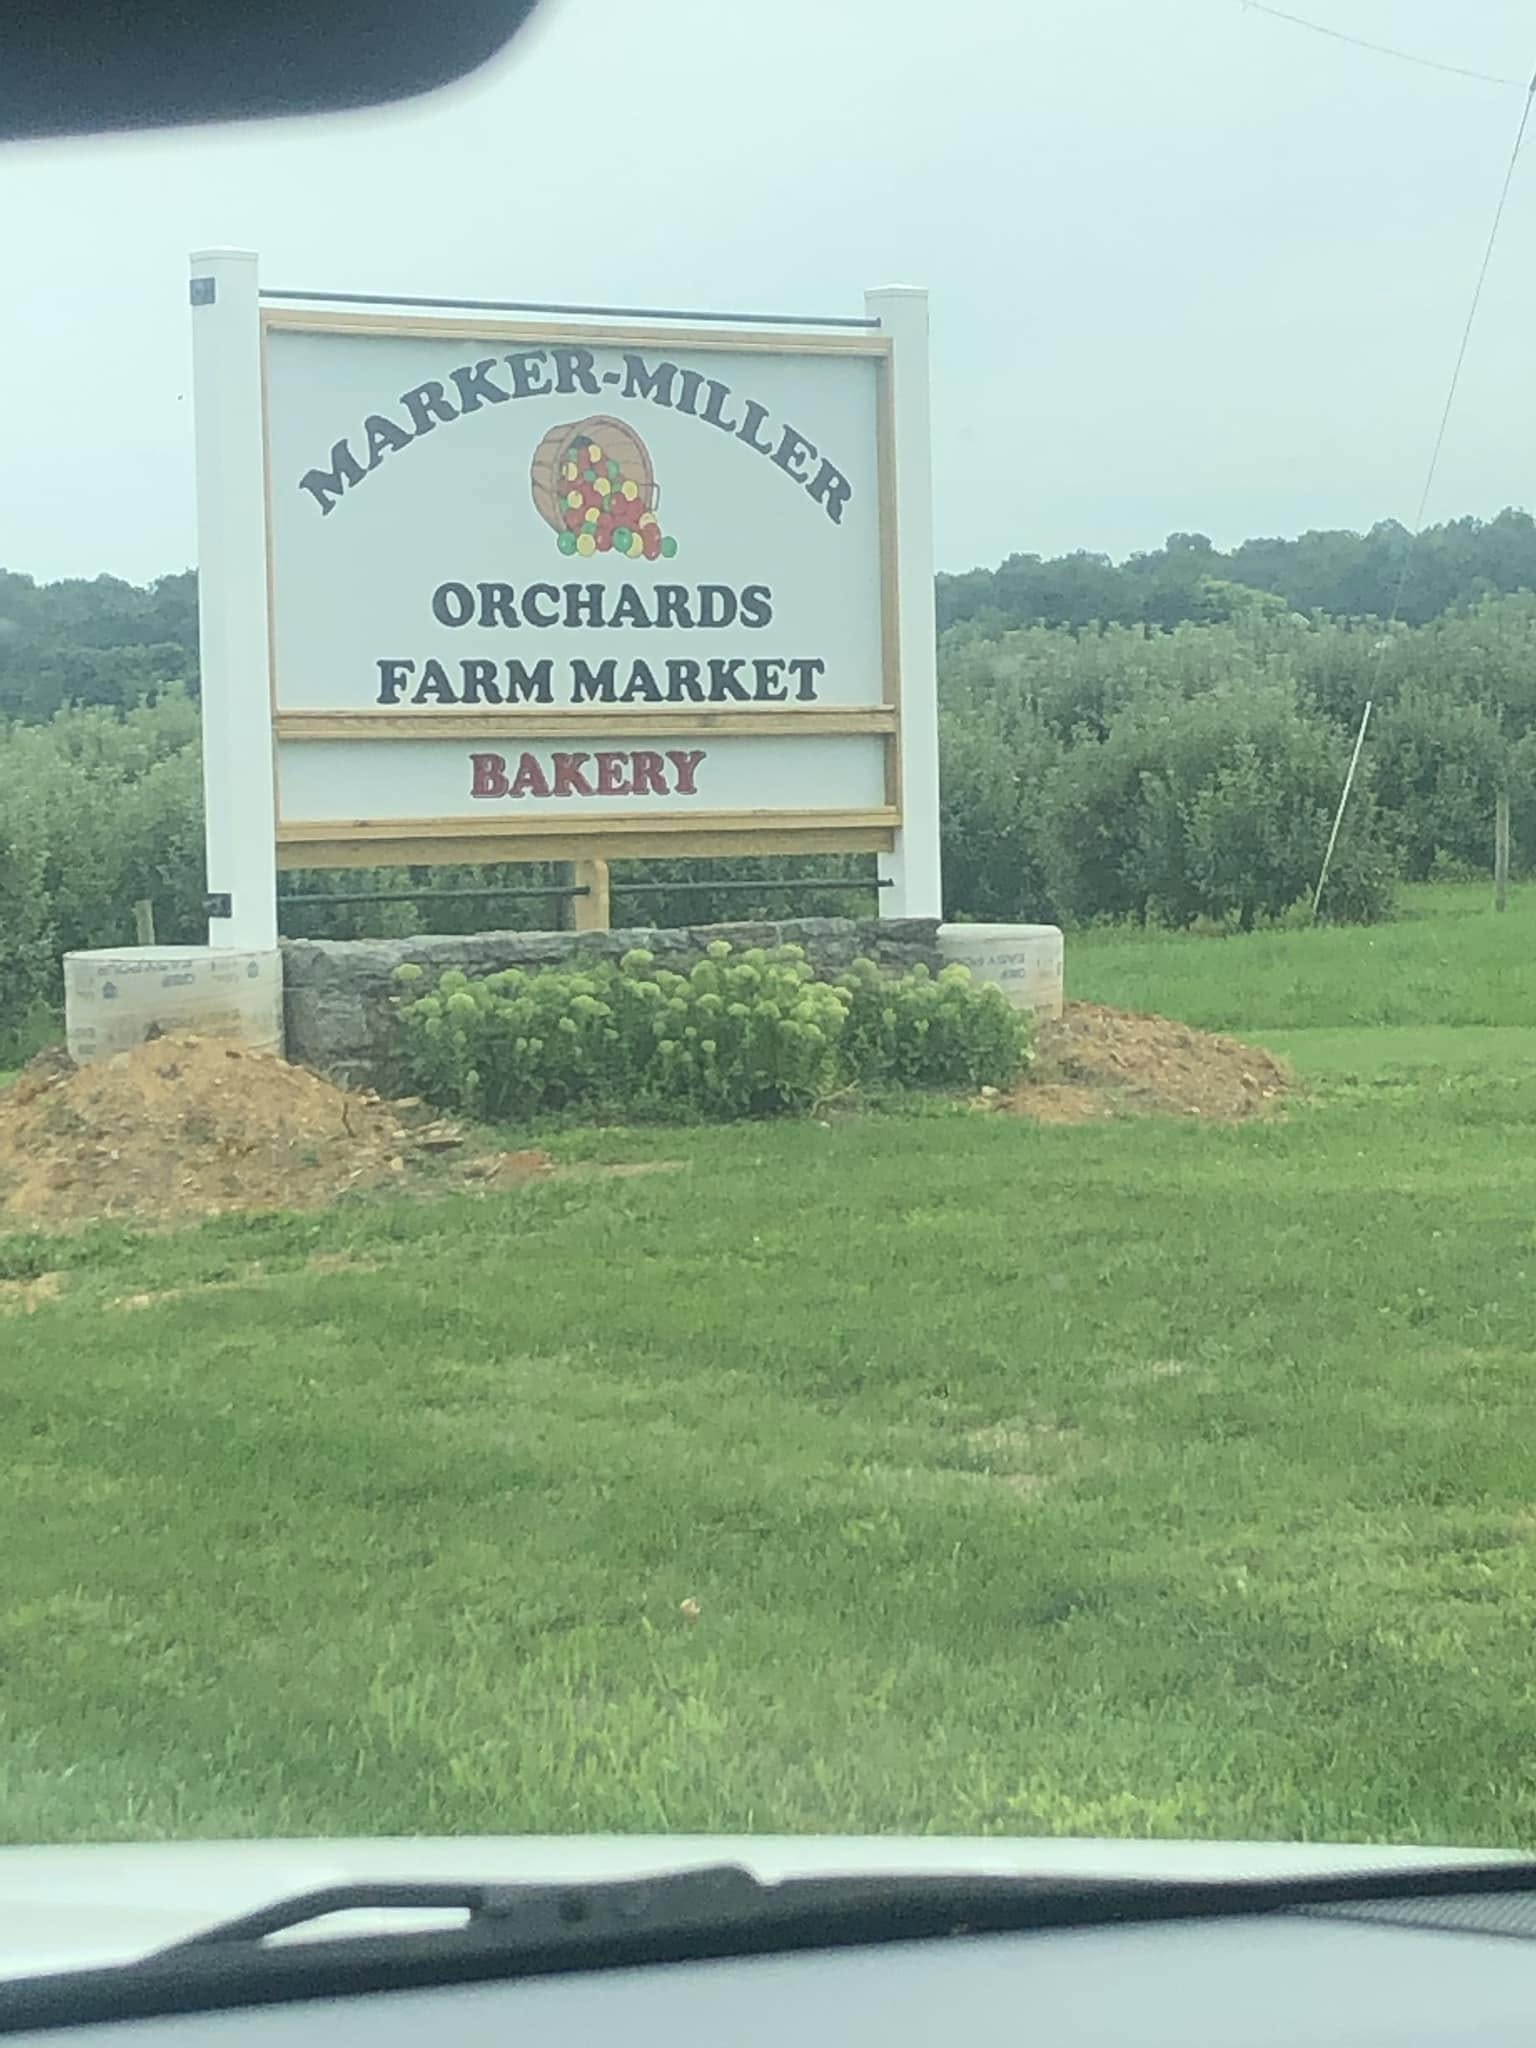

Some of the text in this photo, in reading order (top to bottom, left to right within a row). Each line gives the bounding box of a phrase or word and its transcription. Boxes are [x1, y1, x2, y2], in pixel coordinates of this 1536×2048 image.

[299, 347, 853, 525] MARKER-MILLER
[432, 583, 772, 628] ORCHARDS
[376, 658, 825, 704] FARM MARKET
[469, 750, 707, 798] BAKERY
